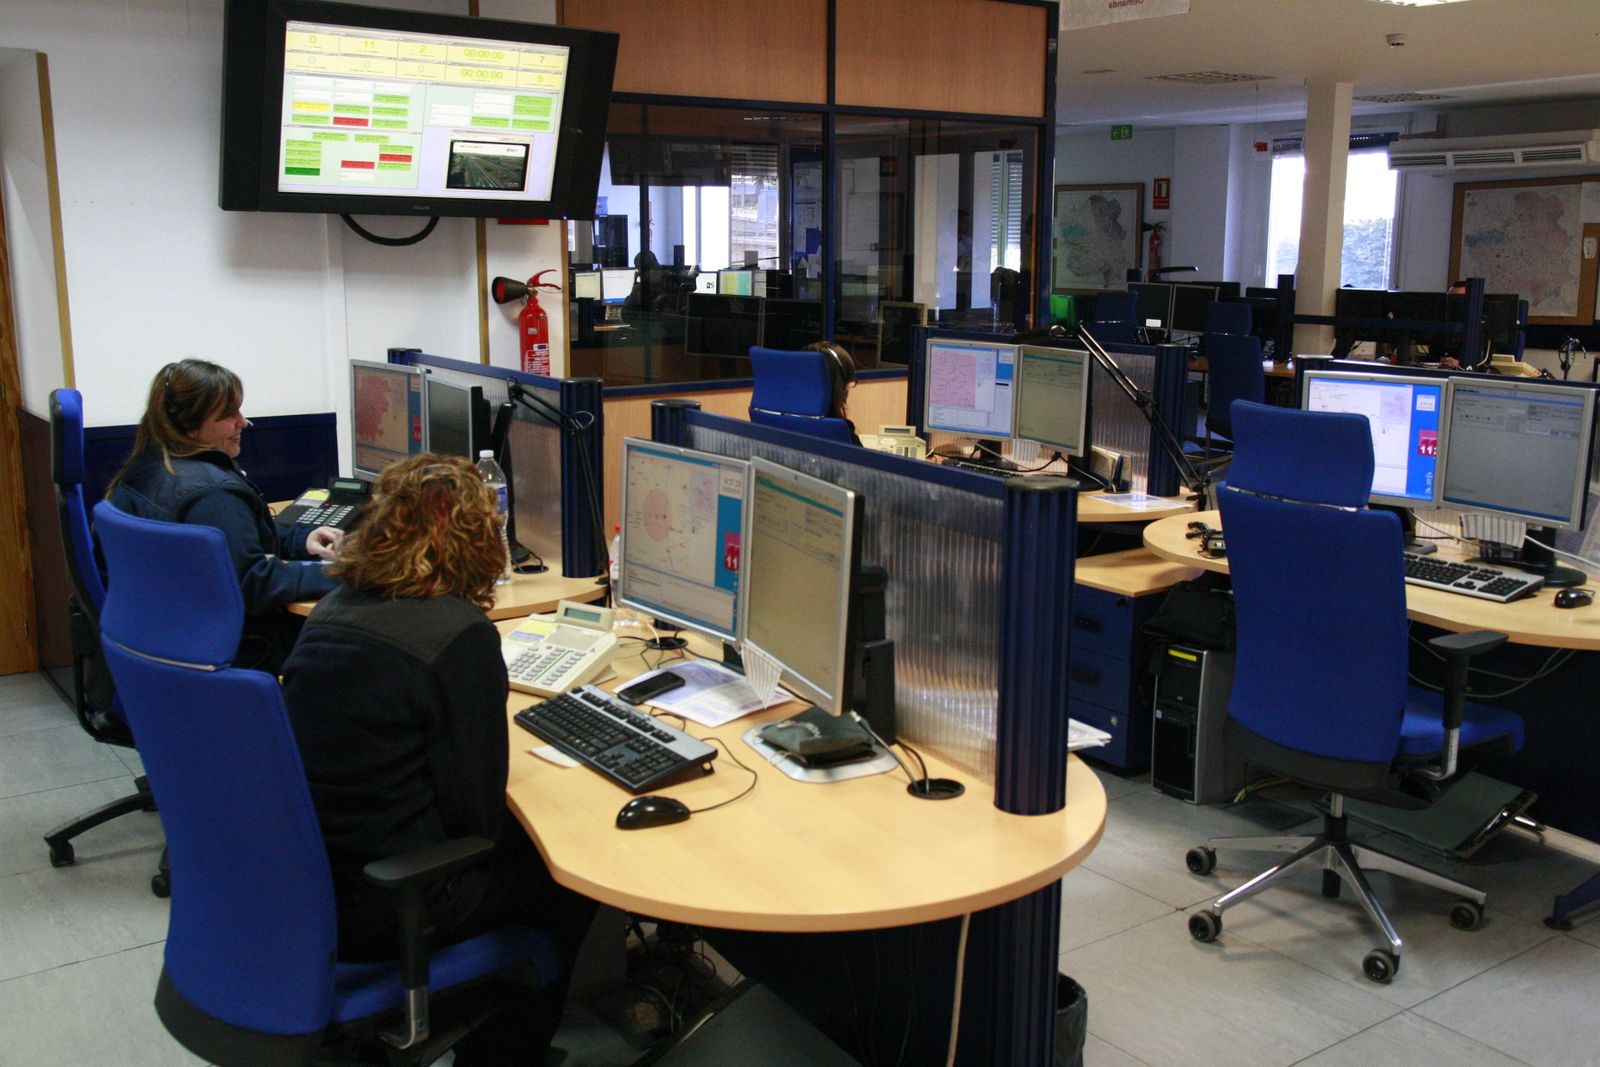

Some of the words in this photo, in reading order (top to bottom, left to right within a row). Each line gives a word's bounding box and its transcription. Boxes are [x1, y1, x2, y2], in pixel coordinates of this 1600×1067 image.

[362, 40, 375, 49] 11
[419, 45, 427, 53] 2
[464, 48, 504, 59] 00:00:00
[539, 55, 545, 63] 7
[417, 65, 425, 73] 0
[460, 68, 503, 79] 00:00:00
